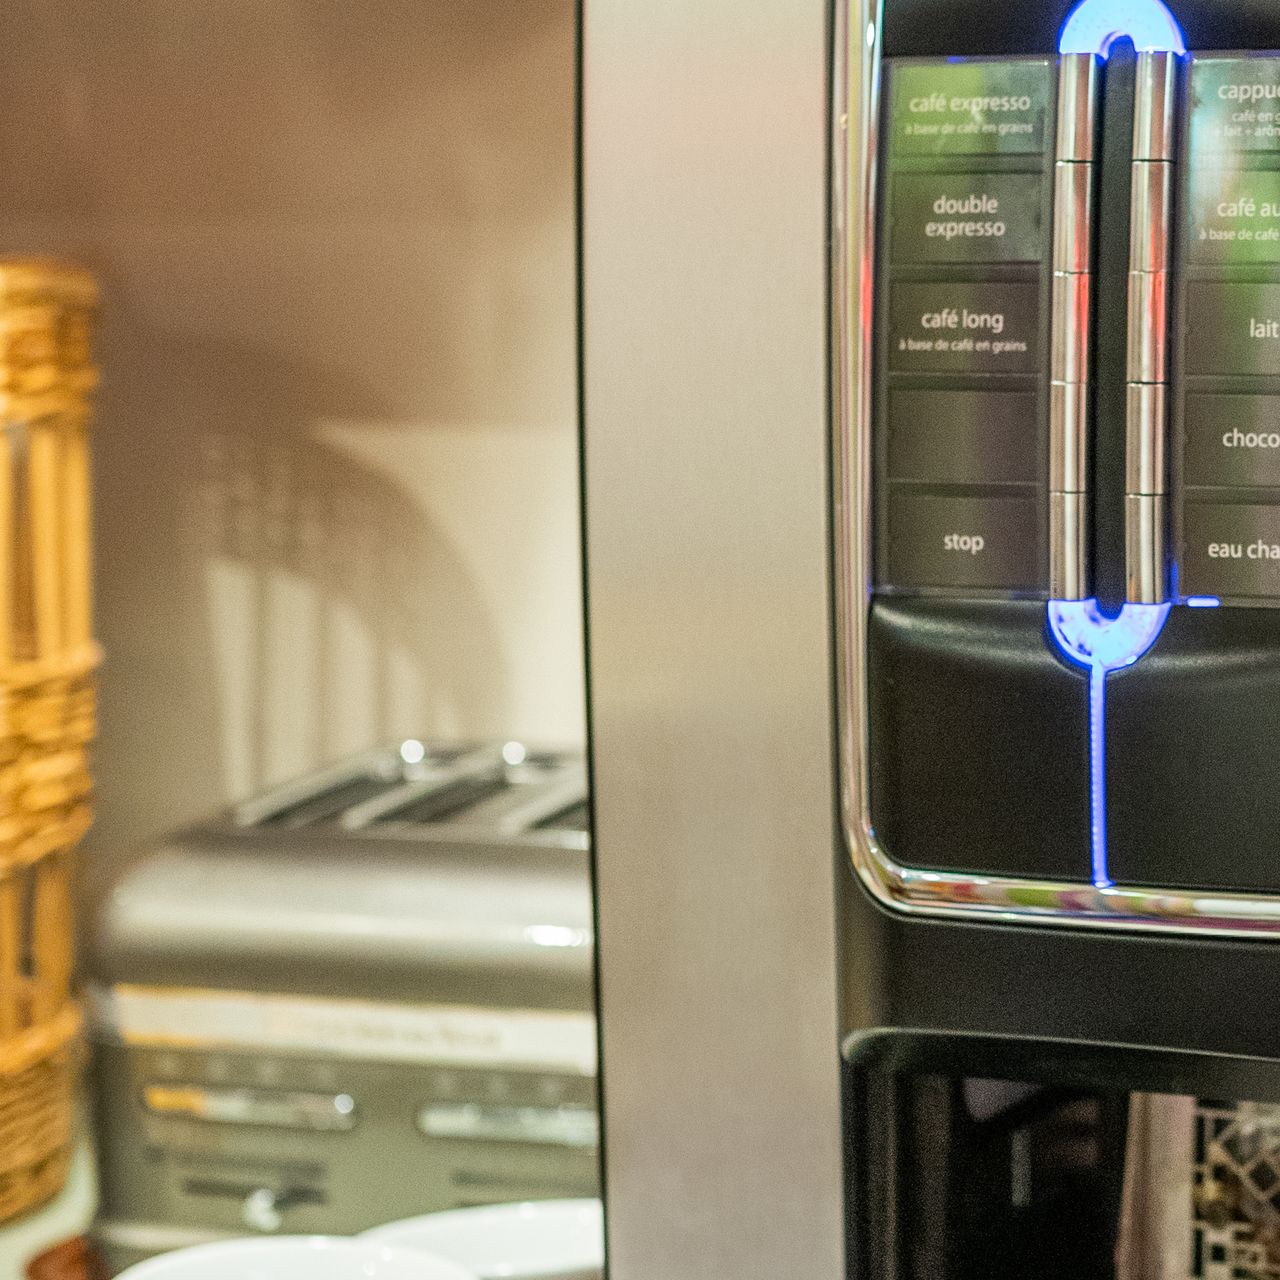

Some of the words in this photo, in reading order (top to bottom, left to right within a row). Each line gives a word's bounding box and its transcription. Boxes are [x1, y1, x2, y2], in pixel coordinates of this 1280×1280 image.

[909, 93, 946, 112] café
[950, 95, 1031, 117] expresso
[1232, 110, 1256, 122] café
[1257, 112, 1273, 122] en
[941, 122, 957, 133] de
[982, 124, 997, 133] en
[999, 123, 1033, 136] grains
[1223, 125, 1242, 136] lait
[933, 194, 998, 214] double
[1216, 198, 1255, 217] café
[925, 221, 1006, 241] expresso
[1208, 228, 1236, 240] base
[1237, 228, 1253, 240] de
[1254, 227, 1279, 240] café
[921, 309, 958, 328] café
[962, 309, 1004, 333] long
[1250, 318, 1279, 338] lait
[907, 338, 933, 351] base
[934, 339, 949, 351] de
[950, 338, 974, 351] café
[975, 341, 990, 351] en
[992, 340, 1027, 354] grains
[944, 533, 985, 555] stop
[1208, 543, 1242, 558] eau
